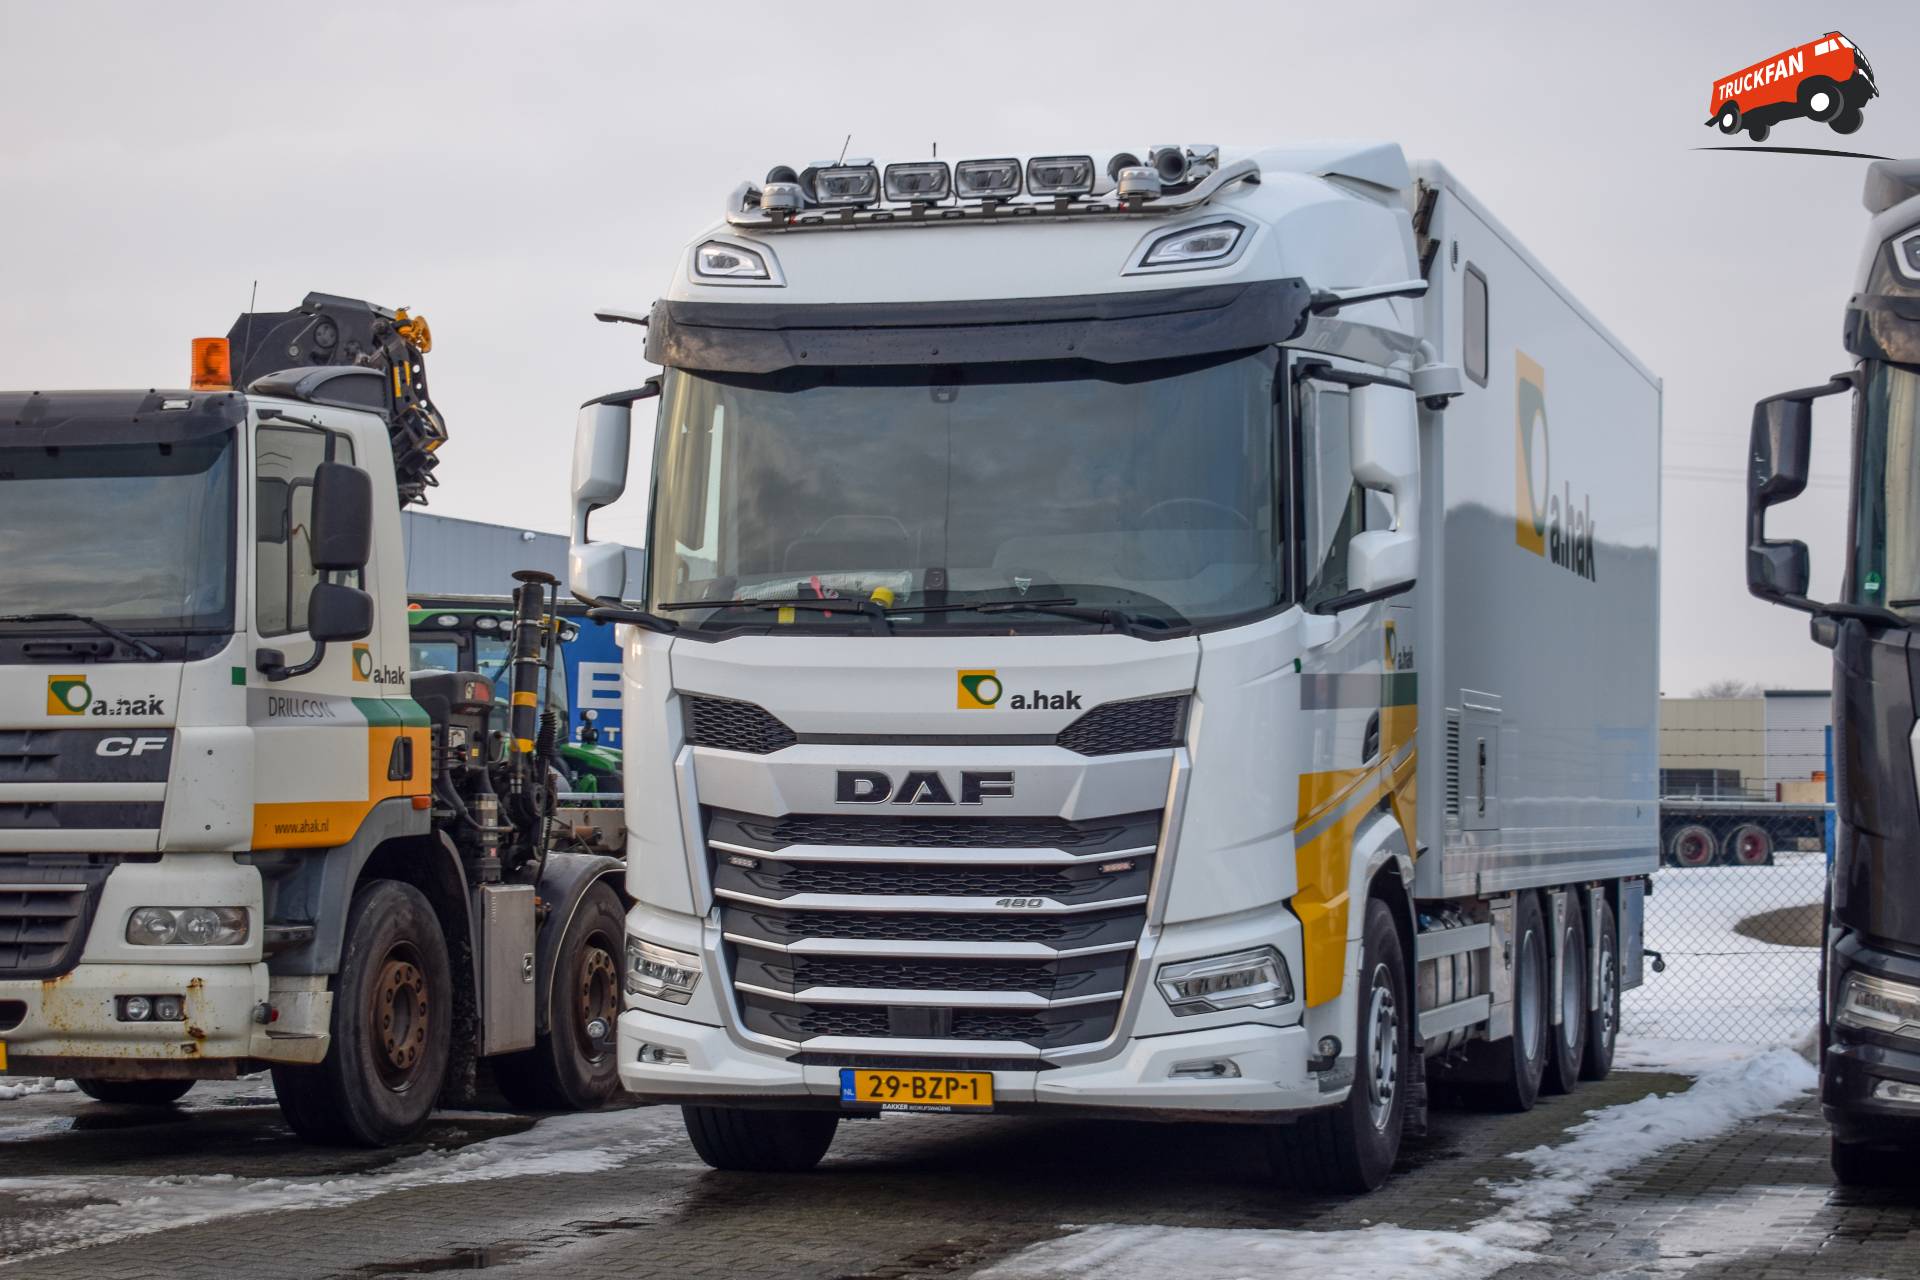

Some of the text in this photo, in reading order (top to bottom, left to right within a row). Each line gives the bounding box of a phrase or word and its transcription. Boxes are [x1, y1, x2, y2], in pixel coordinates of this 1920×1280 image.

[374, 665, 405, 684] a.hak
[1011, 690, 1082, 710] a.hak
[96, 737, 168, 757] CF
[835, 770, 1015, 805] DAF
[274, 819, 329, 834] www.ahak.nl
[996, 898, 1043, 908] 480
[843, 1075, 978, 1100] NL 29-BZP-1
